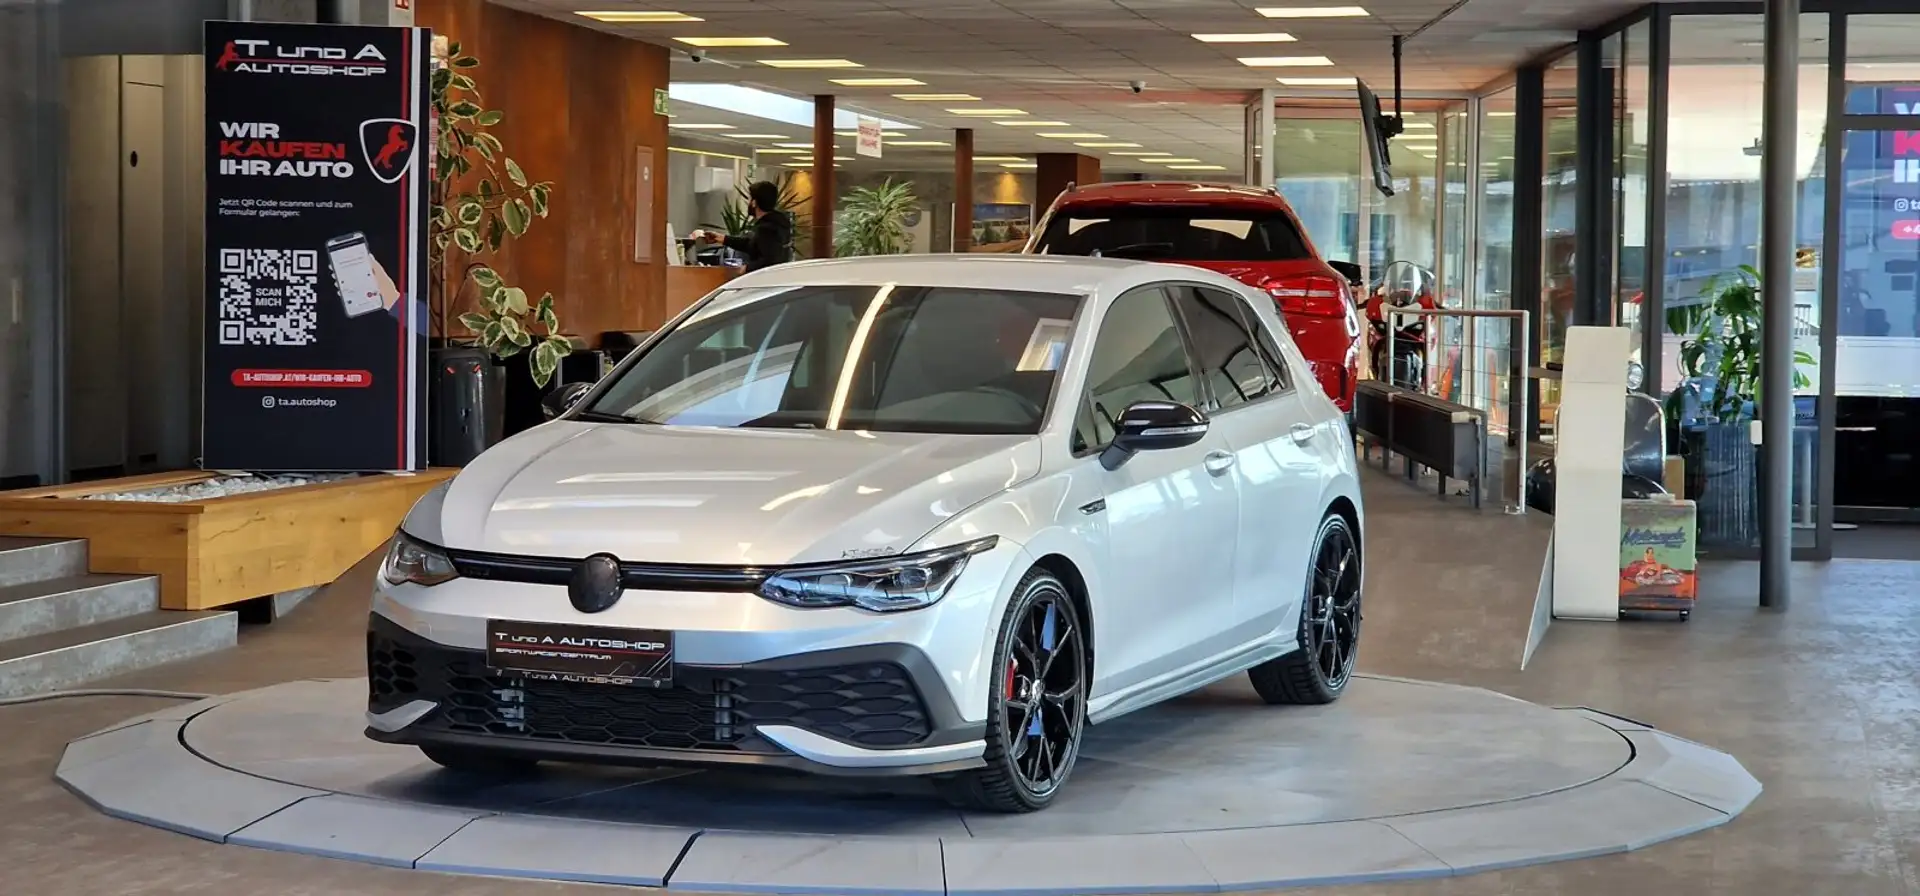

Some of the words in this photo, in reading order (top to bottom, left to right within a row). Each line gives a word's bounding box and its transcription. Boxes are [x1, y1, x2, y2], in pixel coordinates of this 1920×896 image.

[234, 39, 270, 57] T
[353, 43, 387, 61] A
[234, 62, 387, 77] AUTOSHOP
[219, 121, 280, 139] WIR
[219, 140, 346, 160] KAUFEN
[219, 159, 271, 176] IHR
[273, 160, 354, 178] AUTO
[218, 198, 240, 207] Jetzt
[241, 198, 255, 207] QR
[256, 199, 278, 208] Code
[279, 200, 314, 208] scannen
[315, 200, 333, 209] und
[334, 201, 353, 209] zum
[218, 207, 257, 216] Formular
[259, 208, 300, 218] gelangen:
[255, 288, 282, 297] SCAN
[254, 297, 282, 307] MICH
[278, 397, 337, 408] ta.autoshop
[495, 632, 508, 641] T
[542, 635, 554, 644] A
[559, 636, 665, 650] AUTOSHOP
[562, 674, 633, 685] AUTOSHOP
